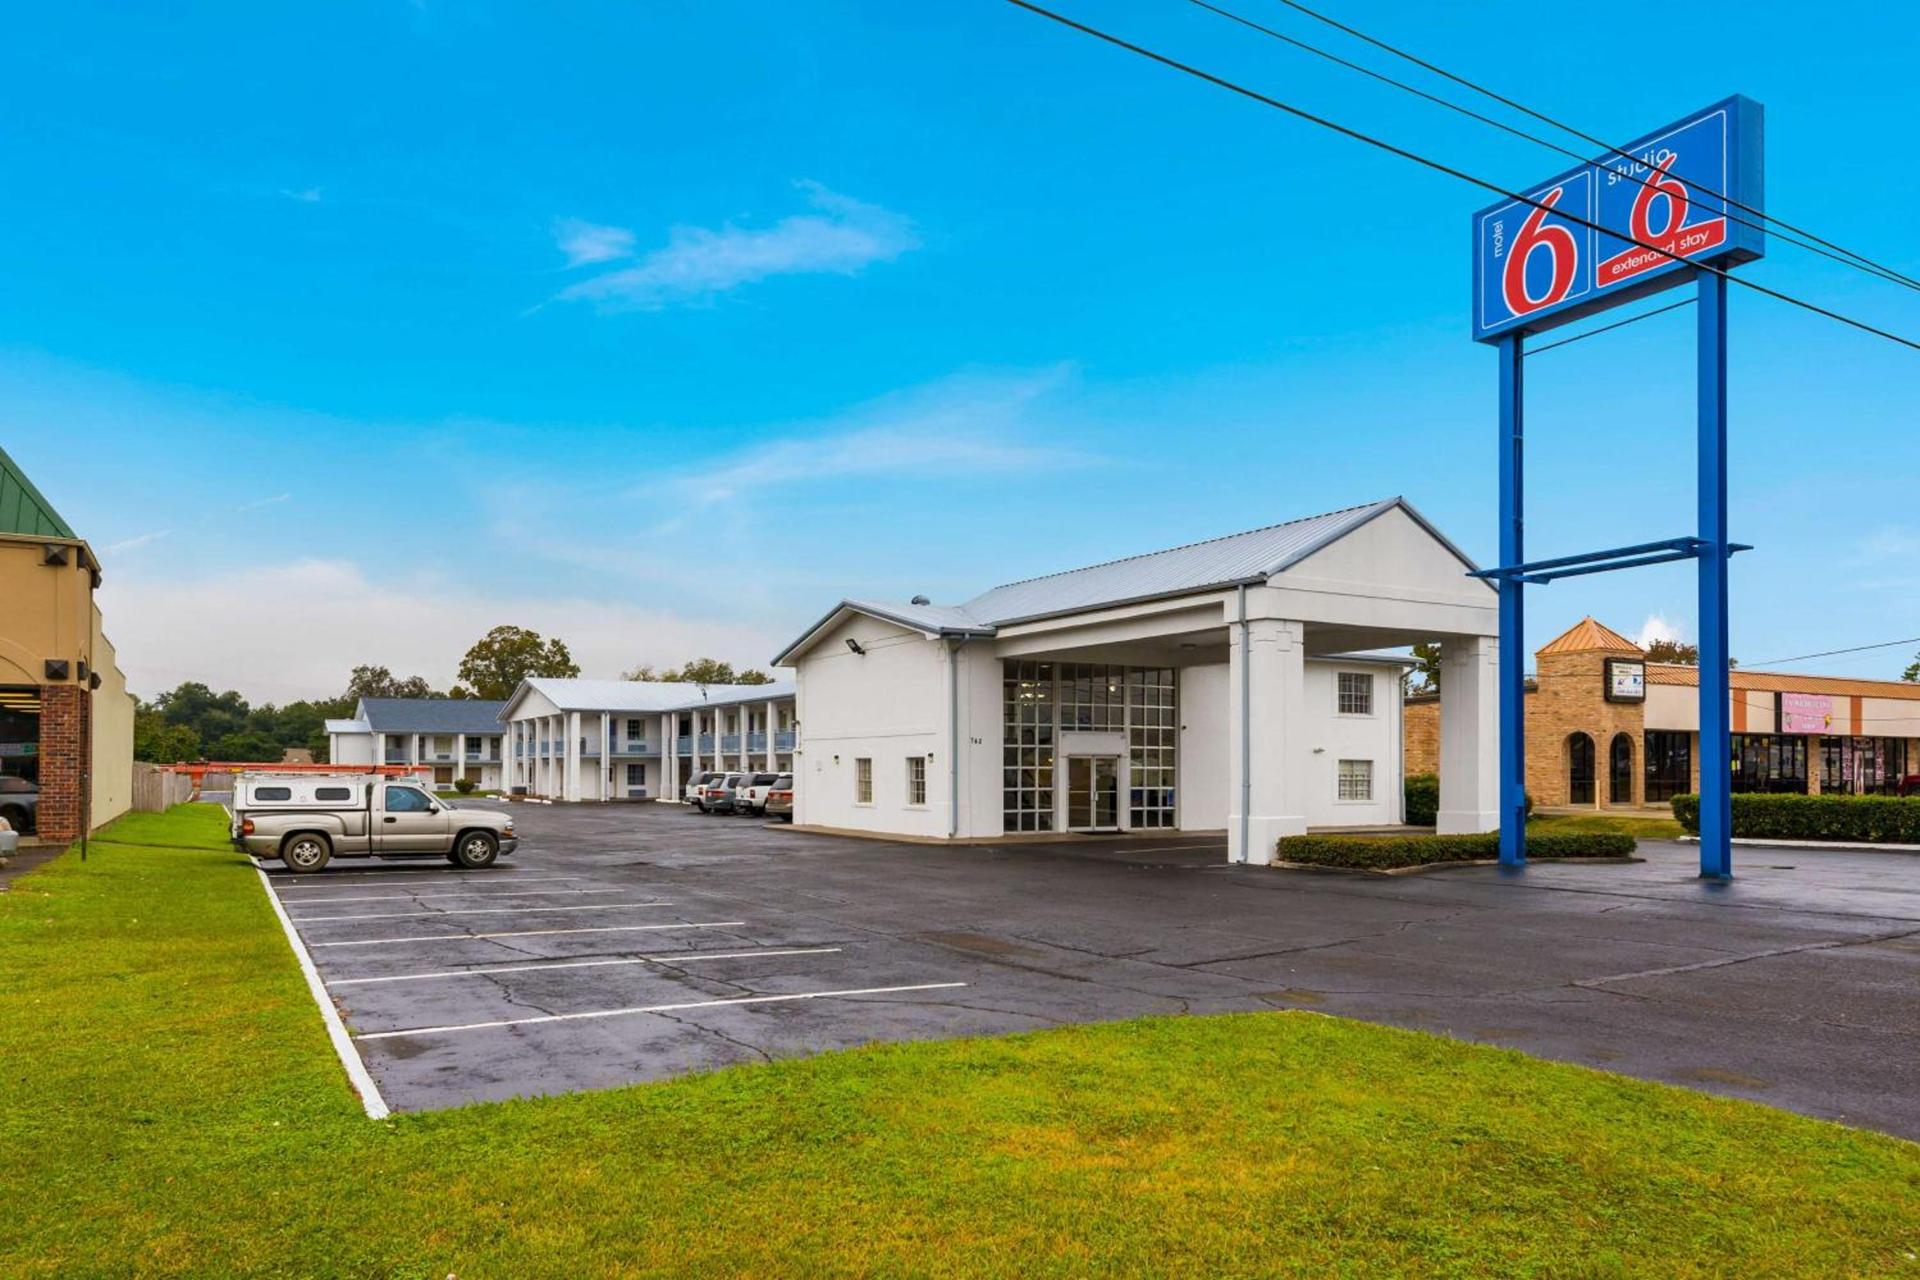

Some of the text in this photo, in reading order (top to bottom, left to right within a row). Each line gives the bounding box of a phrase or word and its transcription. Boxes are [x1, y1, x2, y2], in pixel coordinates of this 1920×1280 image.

[1607, 149, 1670, 186] studio
[1630, 153, 1687, 240] 6
[1493, 220, 1503, 258] motel
[1503, 187, 1577, 315] 6
[1680, 230, 1710, 250] stay
